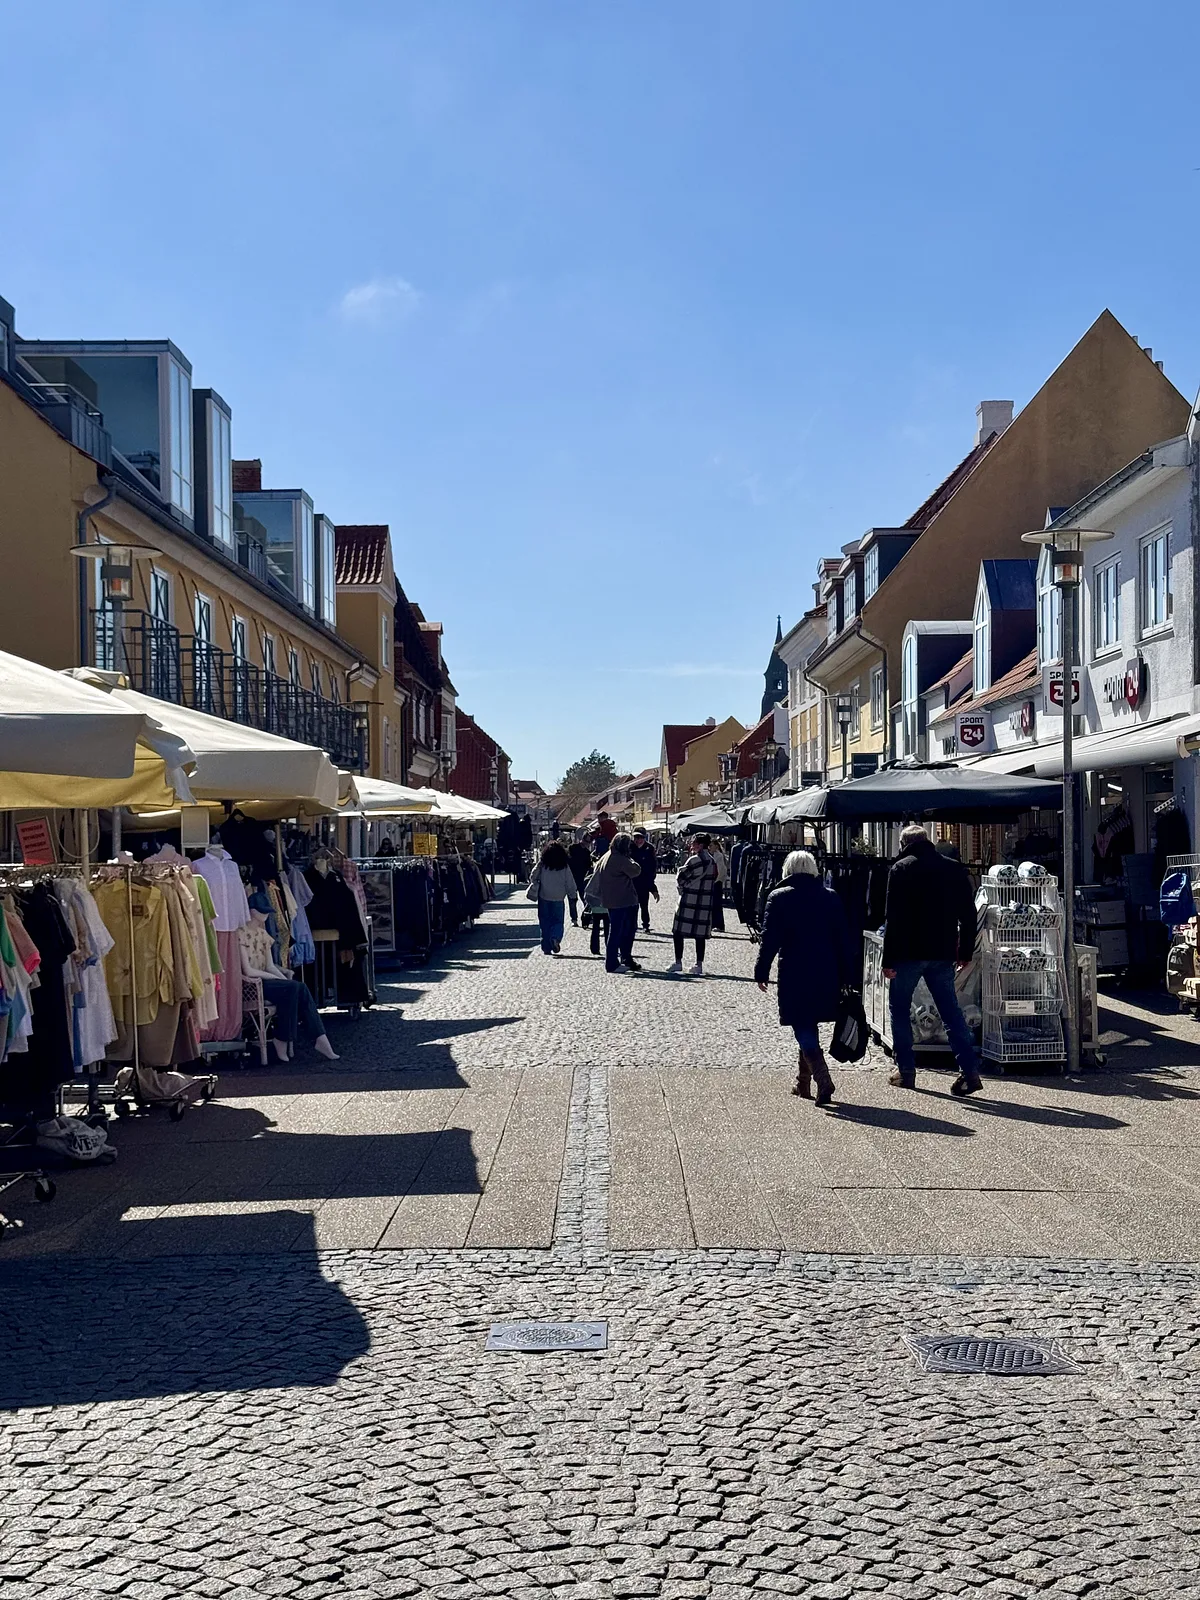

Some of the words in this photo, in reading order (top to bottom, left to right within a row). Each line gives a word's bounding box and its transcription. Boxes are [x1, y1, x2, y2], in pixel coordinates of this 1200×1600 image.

[1049, 671, 1079, 679] SPT
[1102, 670, 1126, 703] SPORT
[1127, 667, 1139, 697] 24
[963, 728, 983, 741] 24
